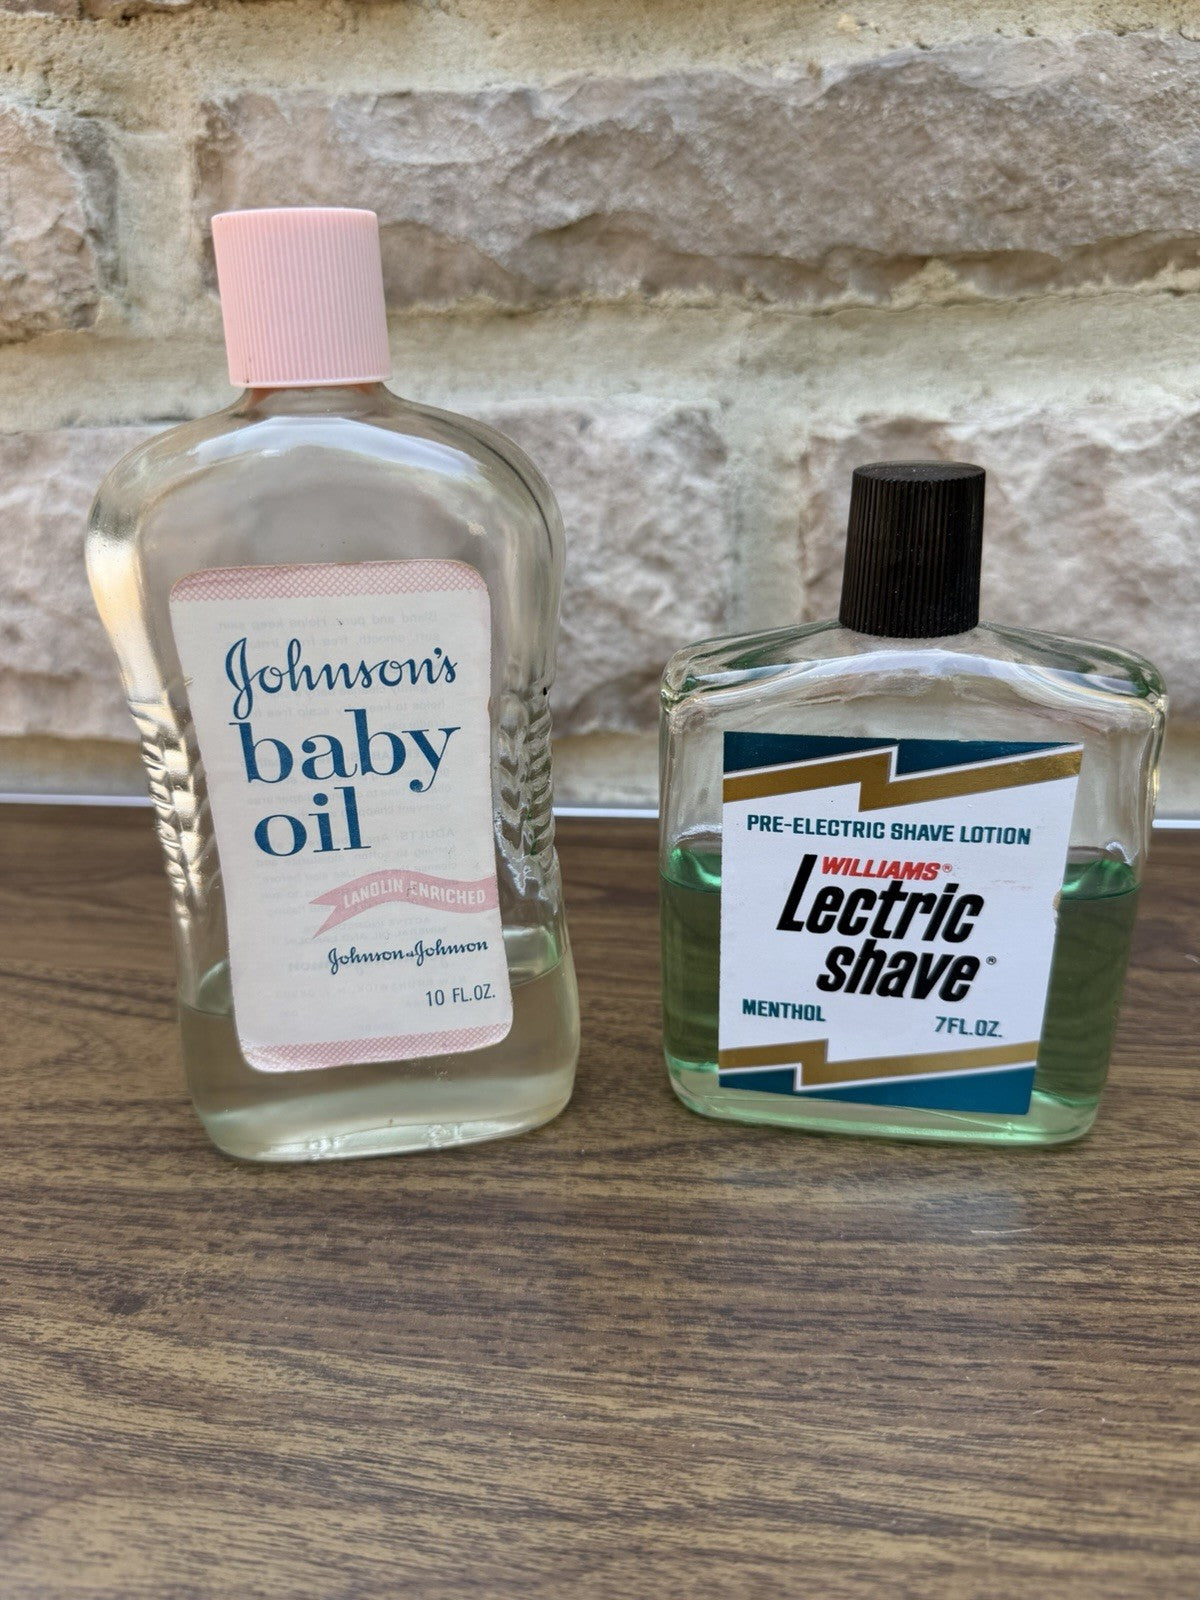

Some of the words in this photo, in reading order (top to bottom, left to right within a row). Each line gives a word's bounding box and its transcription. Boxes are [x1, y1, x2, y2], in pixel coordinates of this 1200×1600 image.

[225, 637, 458, 720] Johnson's
[229, 708, 461, 792] baby
[254, 786, 371, 856] oil
[747, 814, 885, 839] PRE-ELECTRIC
[891, 822, 954, 843] SHAVE
[960, 826, 1031, 845] LOTION
[343, 878, 403, 910] LANOLIN
[410, 880, 486, 905] ENRICHED
[776, 854, 984, 943] Lectric
[328, 947, 404, 975] Johnson
[414, 939, 488, 966] Johnson
[426, 989, 445, 1007] 10
[742, 998, 826, 1022] MENTHOL
